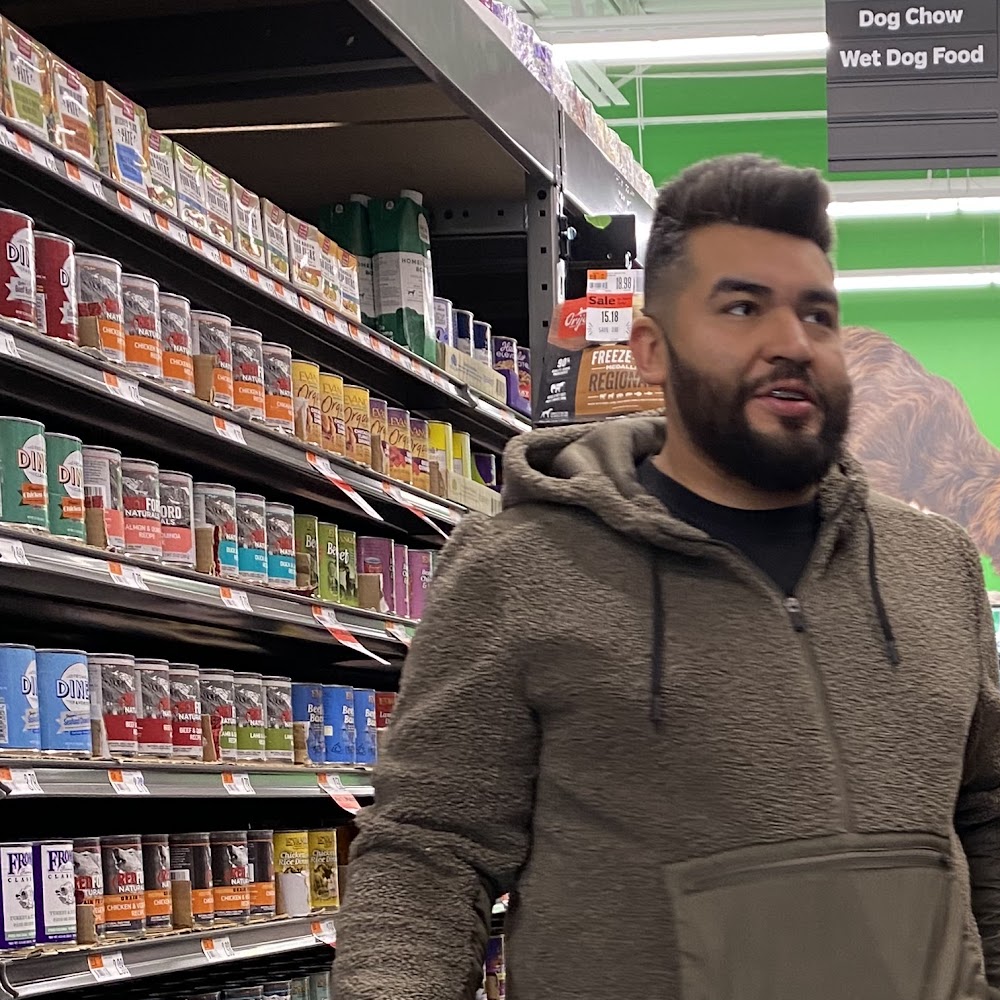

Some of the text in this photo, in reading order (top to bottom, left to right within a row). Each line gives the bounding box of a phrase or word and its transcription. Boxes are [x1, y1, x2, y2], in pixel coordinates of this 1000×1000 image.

[858, 8, 963, 30] Dog Chow
[840, 45, 984, 69] Wet Dog Food
[589, 296, 616, 306] Sale
[601, 311, 619, 323] 15.18
